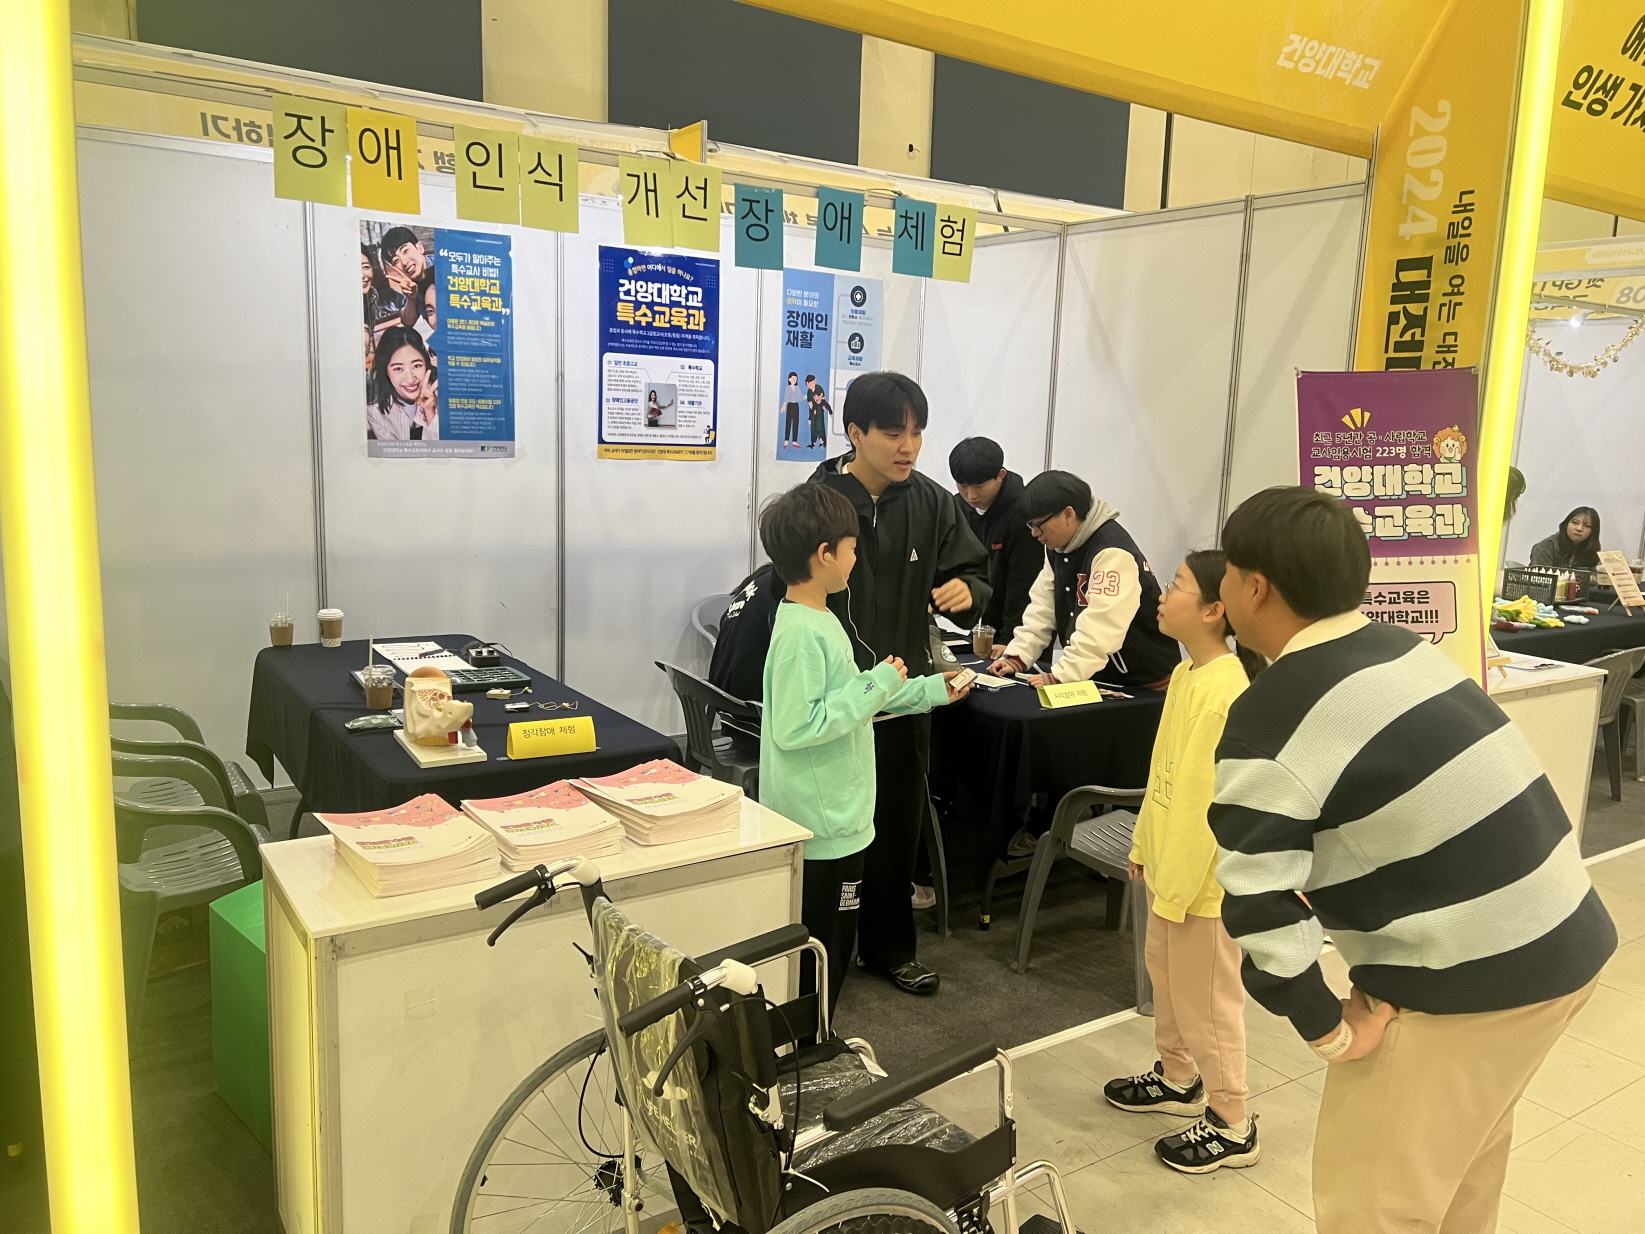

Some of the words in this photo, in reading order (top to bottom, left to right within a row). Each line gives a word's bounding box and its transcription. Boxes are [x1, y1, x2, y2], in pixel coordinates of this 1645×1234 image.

[1276, 33, 1381, 89] 건양대학교
[1561, 64, 1625, 117] 인생
[1398, 99, 1452, 241] 2024
[1444, 189, 1475, 266] 내일을
[472, 253, 501, 266] 알아주는
[451, 263, 480, 276] 특수교사
[482, 266, 499, 278] 비법!
[647, 263, 666, 272] 어디에서
[667, 265, 676, 274] 일을
[447, 275, 501, 294] 건양대학교
[618, 279, 703, 307] 건양대학교
[786, 288, 802, 298] 다양한
[803, 290, 820, 299] 분야의
[1438, 274, 1466, 324] 여는
[803, 299, 819, 308] 필요한
[616, 302, 706, 331] 특수교육과
[786, 310, 828, 331] 장애인
[785, 330, 814, 349] 재활
[1312, 431, 1332, 444] 최근
[1335, 431, 1364, 445] 5년간
[1311, 446, 1373, 461] 교사임용시험
[1375, 446, 1407, 459] 223명
[1410, 445, 1432, 459] 합격
[1314, 463, 1466, 499] 건양대학교
[1088, 571, 1120, 596] 23
[1361, 609, 1439, 624] 양대학교!!!
[1054, 690, 1076, 699] 시각장애
[522, 727, 556, 739] 청각장애
[559, 725, 576, 734] 체험
[1146, 1085, 1164, 1098] N
[1205, 1140, 1224, 1156] N
